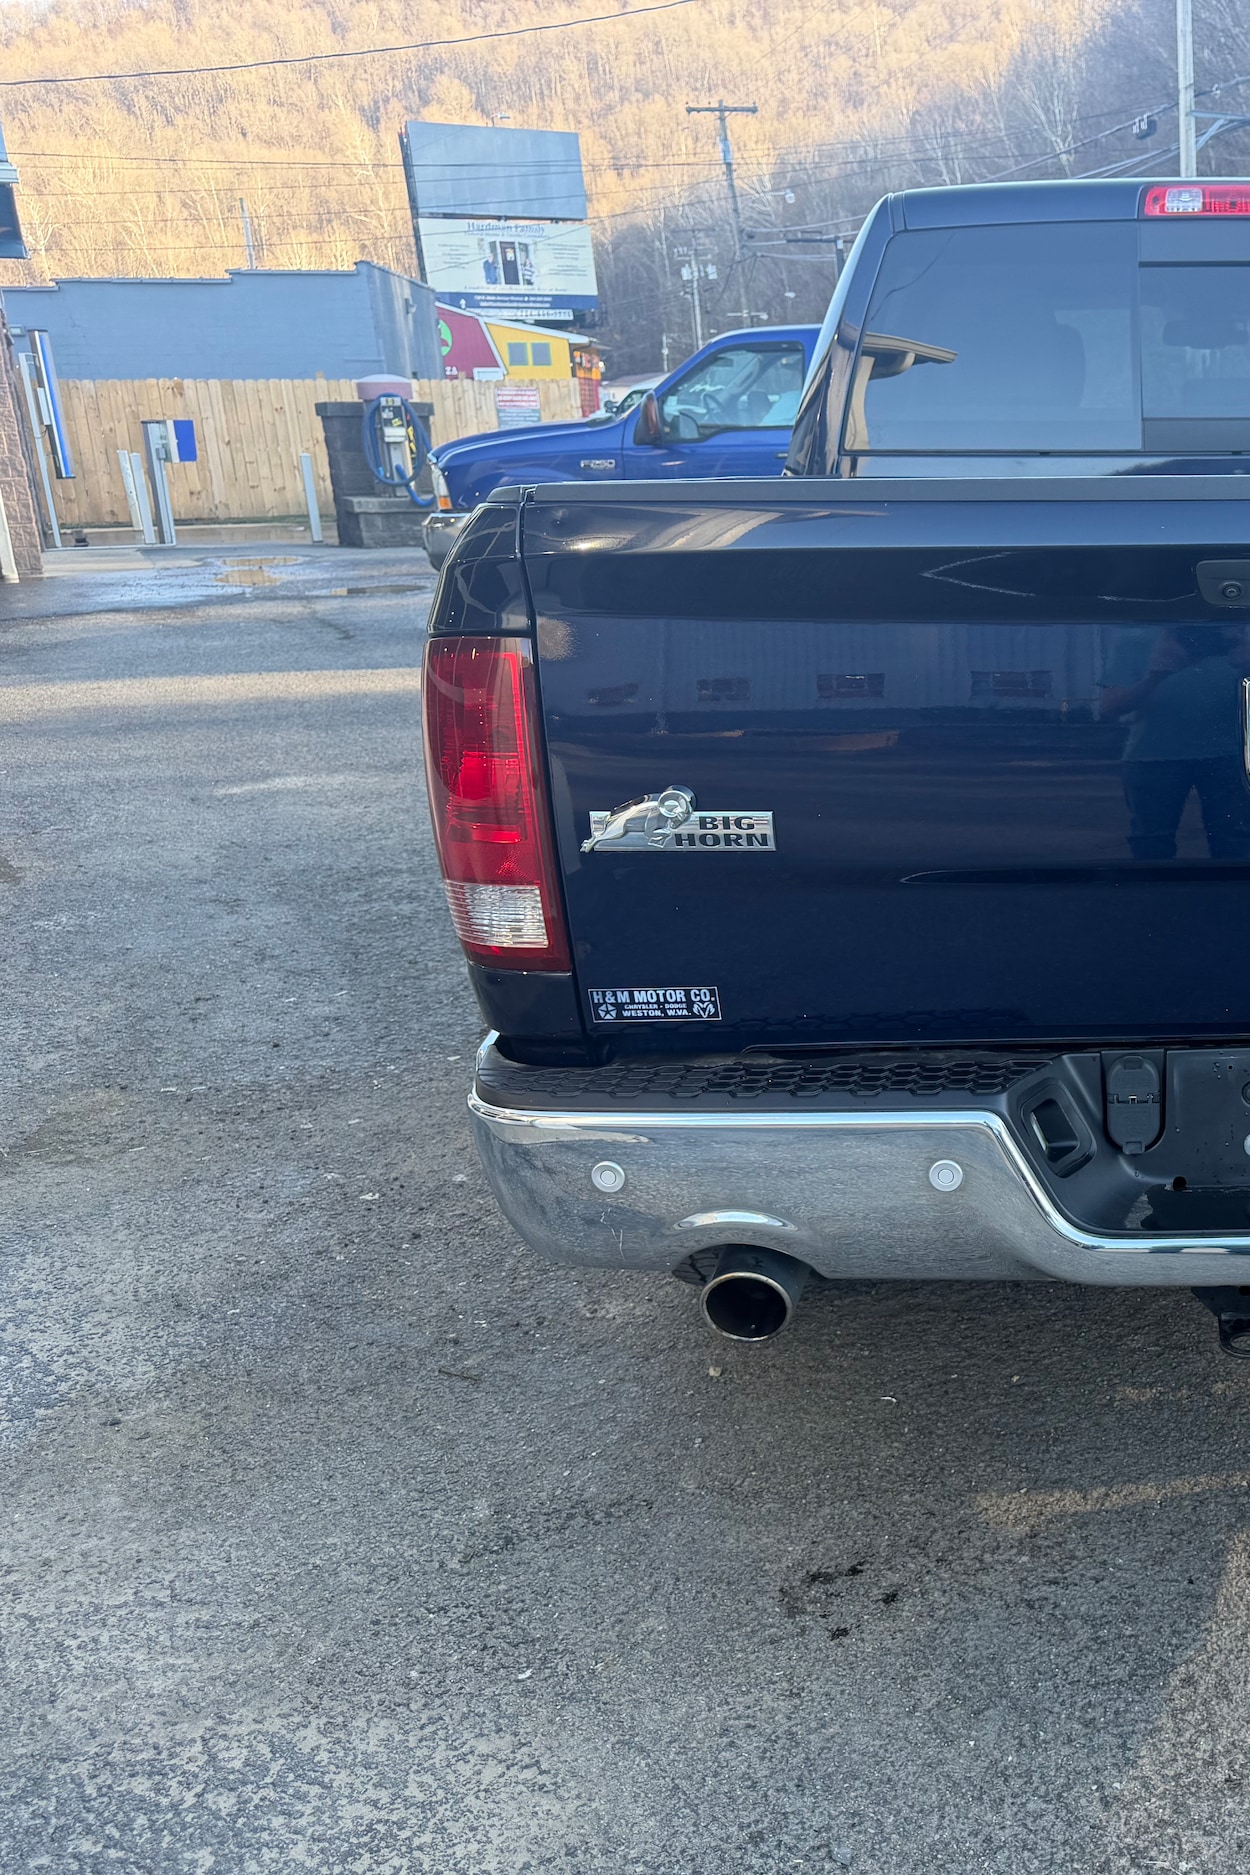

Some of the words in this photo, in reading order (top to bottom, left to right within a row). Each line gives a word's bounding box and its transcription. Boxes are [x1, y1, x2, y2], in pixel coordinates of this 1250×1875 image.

[699, 816, 755, 830] BIG
[674, 833, 769, 847] HORN
[634, 990, 687, 1003] MOTOR
[690, 989, 715, 1002] CO.
[622, 1009, 665, 1017] WESTON,
